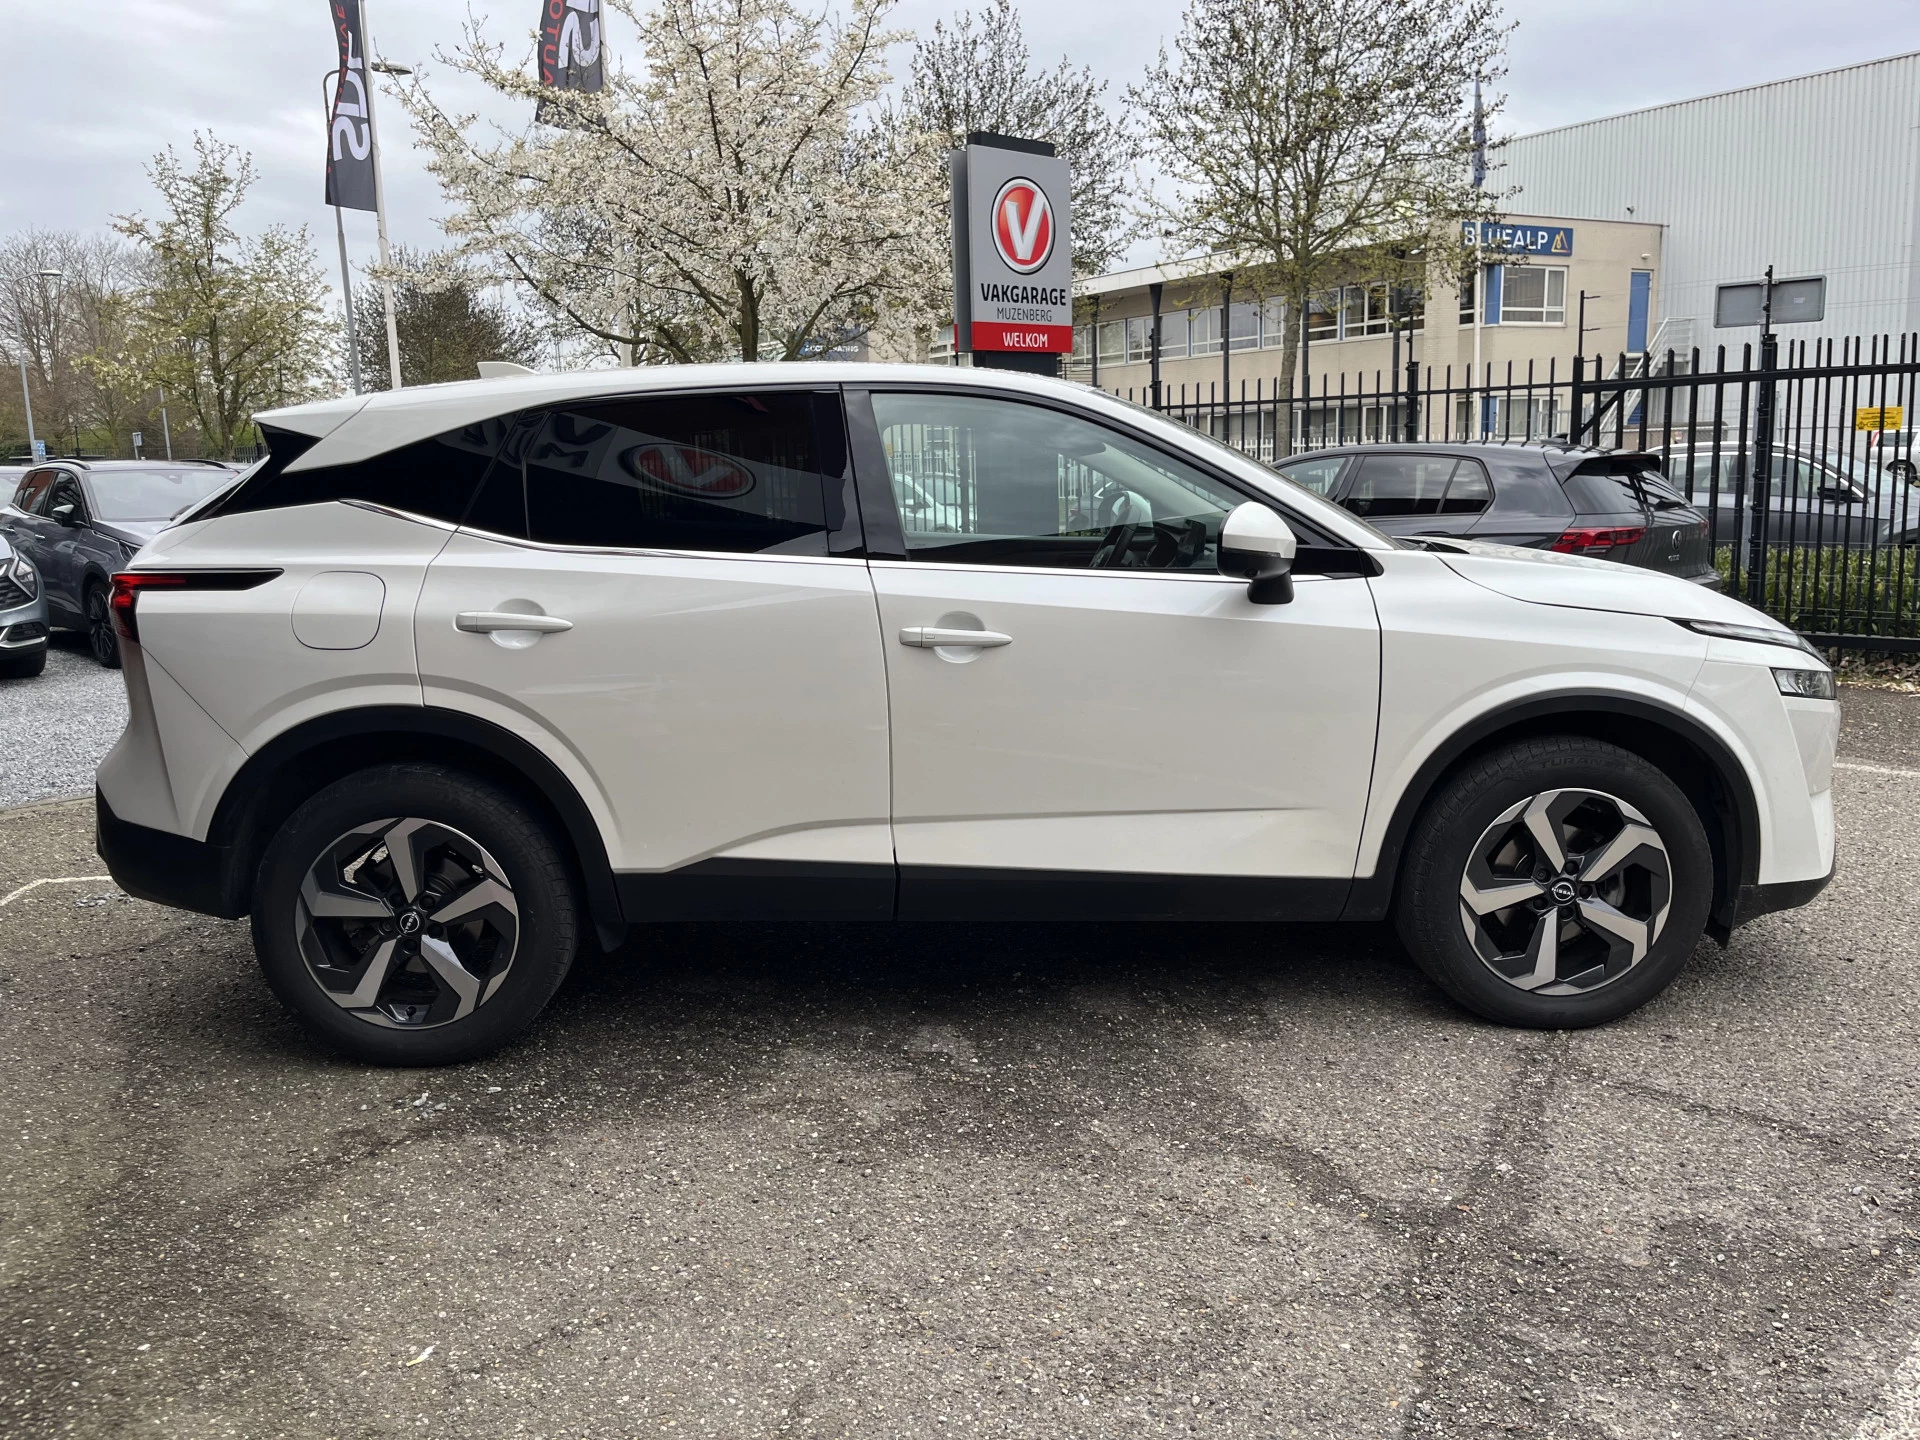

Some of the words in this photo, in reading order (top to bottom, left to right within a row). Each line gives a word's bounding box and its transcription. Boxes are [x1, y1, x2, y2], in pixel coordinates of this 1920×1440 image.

[981, 283, 1067, 306] VAKGARAGE
[996, 307, 1053, 323] MUZENBERG
[1002, 331, 1049, 348] WELKOM
[1551, 887, 1575, 896] NISSAN
